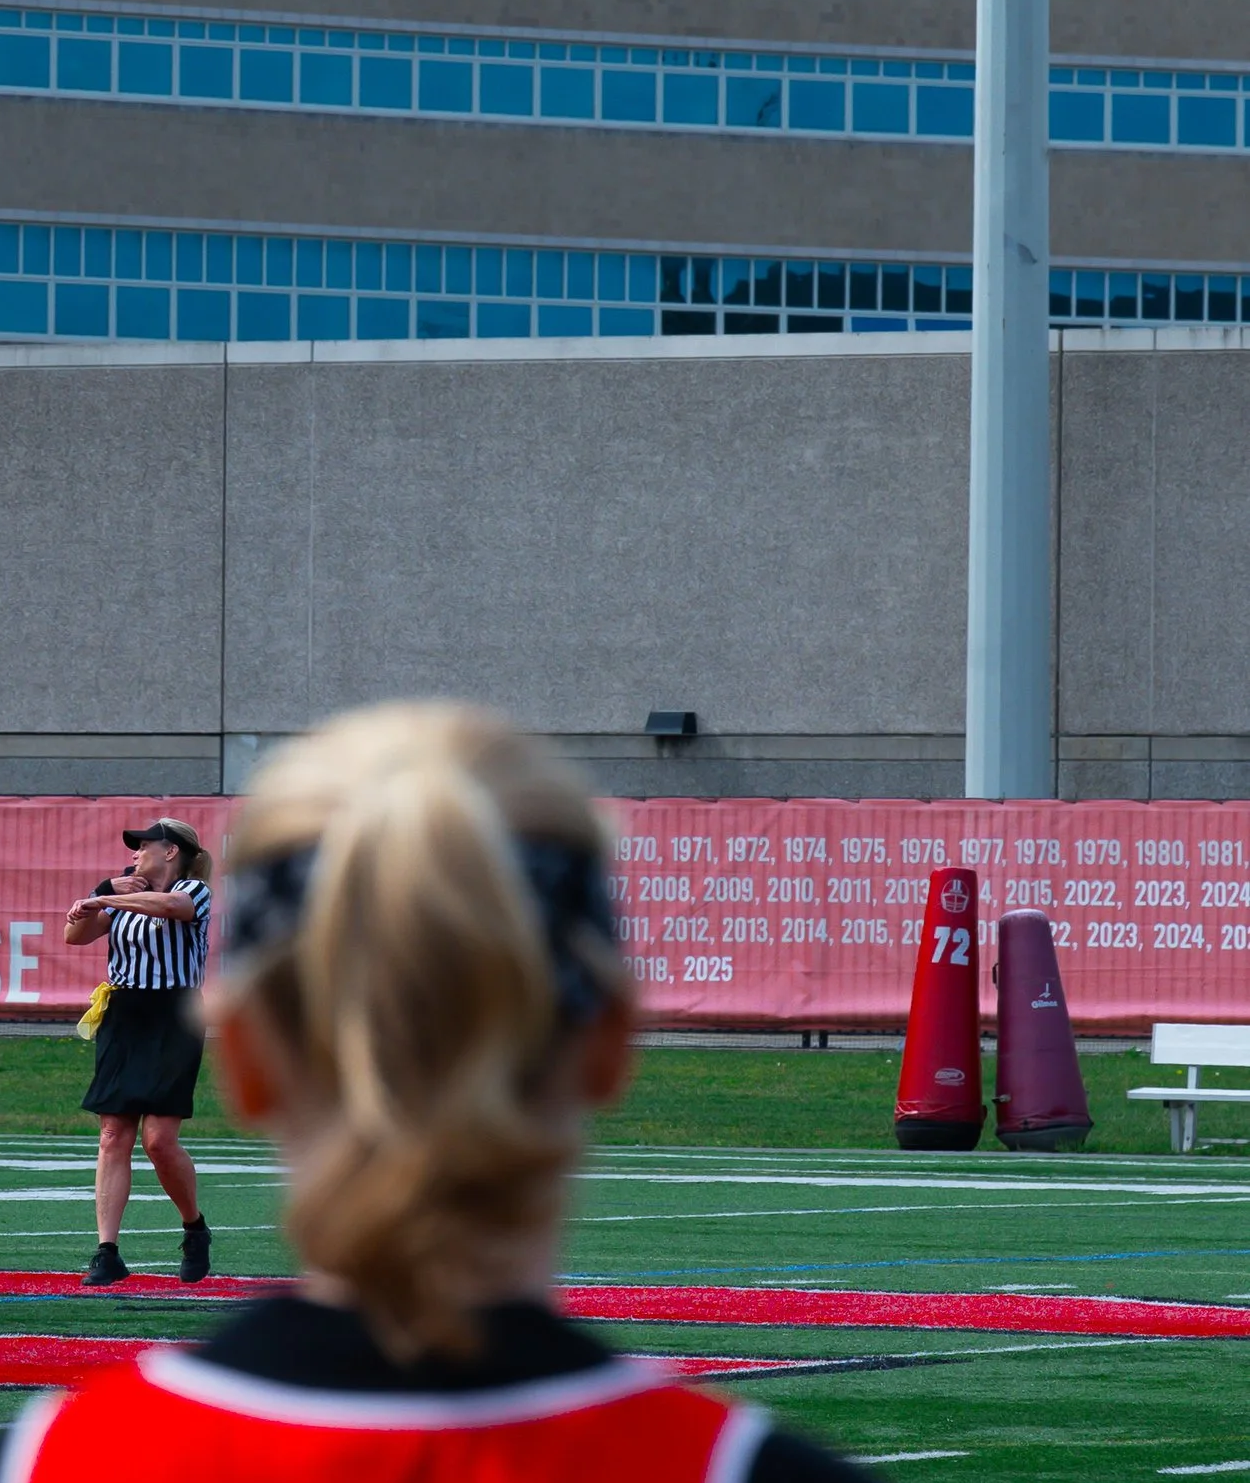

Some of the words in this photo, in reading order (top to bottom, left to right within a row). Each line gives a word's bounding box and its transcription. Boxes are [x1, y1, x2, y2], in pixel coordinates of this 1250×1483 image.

[613, 836, 663, 865] 1970,
[670, 836, 719, 865] 1971,
[726, 836, 776, 866] 1972,
[783, 837, 833, 866] 1974,
[840, 838, 892, 866] 1975,
[900, 838, 951, 866] 1976,
[959, 838, 1007, 867] 1977,
[1014, 839, 1067, 868] 1978,
[1074, 839, 1128, 868] 1979,
[1135, 839, 1190, 869] 1980,
[1197, 840, 1250, 869] 1981,
[639, 876, 696, 905] 2008,
[703, 877, 760, 906] 2009,
[767, 877, 820, 906] 2010,
[827, 878, 877, 907] 2011,
[1005, 879, 1058, 908] 2015,
[1064, 880, 1123, 910] 2022,
[1134, 880, 1190, 910] 2023,
[662, 916, 715, 945] 2012,
[722, 917, 774, 946] 2013,
[781, 918, 834, 946] 2014,
[841, 919, 894, 947] 2015,
[1087, 922, 1143, 952] 2023,
[1153, 923, 1212, 953] 2024,
[931, 926, 971, 966] 72
[683, 955, 734, 982] 2025
